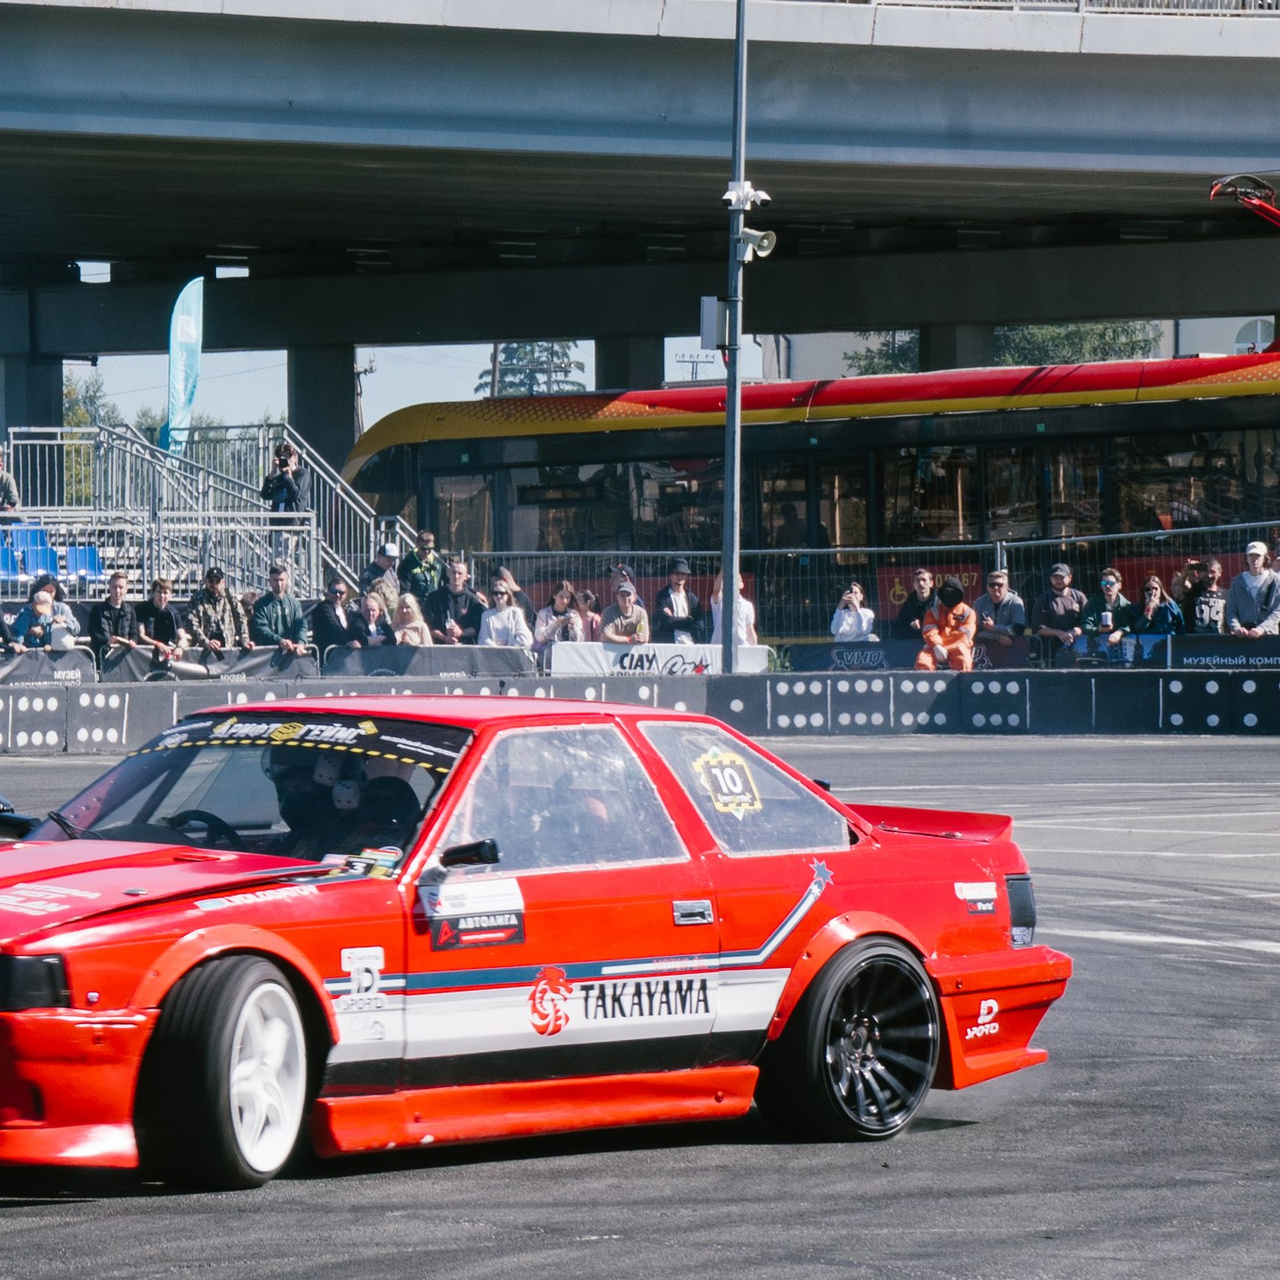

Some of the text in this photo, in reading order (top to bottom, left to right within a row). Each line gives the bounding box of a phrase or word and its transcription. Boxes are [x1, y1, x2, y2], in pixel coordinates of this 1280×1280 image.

[935, 572, 978, 588] 067
[1183, 655, 1247, 665] МУЗЕЙНЫЙ
[53, 667, 82, 680] МУЗЕЙ
[710, 767, 743, 795] 10
[580, 978, 710, 1020] TAKAYAMA
